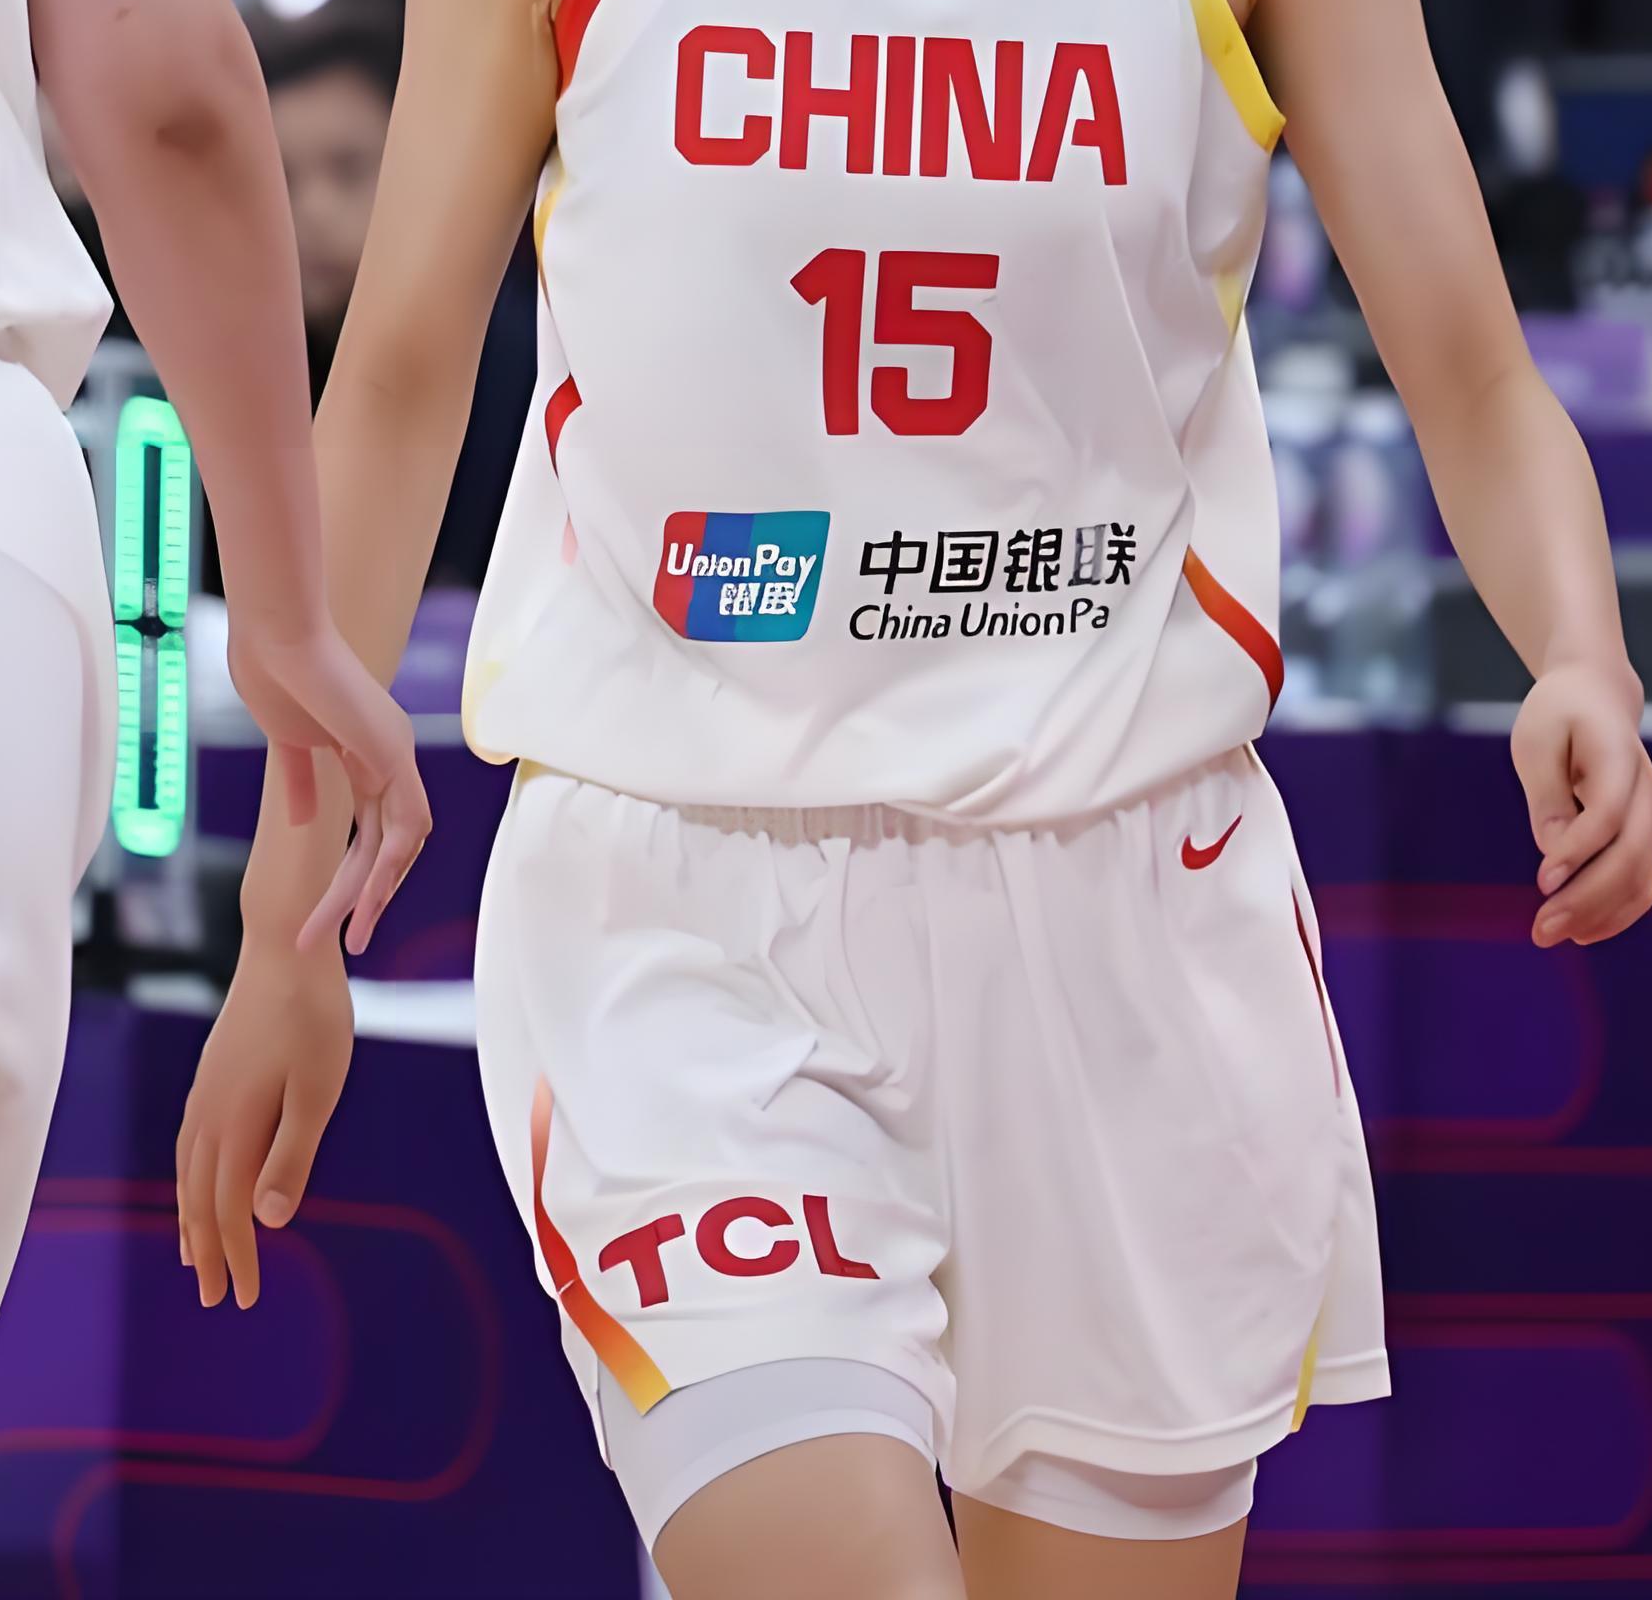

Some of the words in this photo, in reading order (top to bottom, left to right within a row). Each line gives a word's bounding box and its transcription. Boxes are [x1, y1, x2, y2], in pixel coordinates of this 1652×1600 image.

[674, 25, 1128, 186] CHINA
[791, 248, 999, 436] 15
[859, 522, 1136, 594] 中国银联
[850, 603, 950, 640] China
[960, 597, 1110, 638] UnionPa
[598, 1194, 880, 1308] TCL
